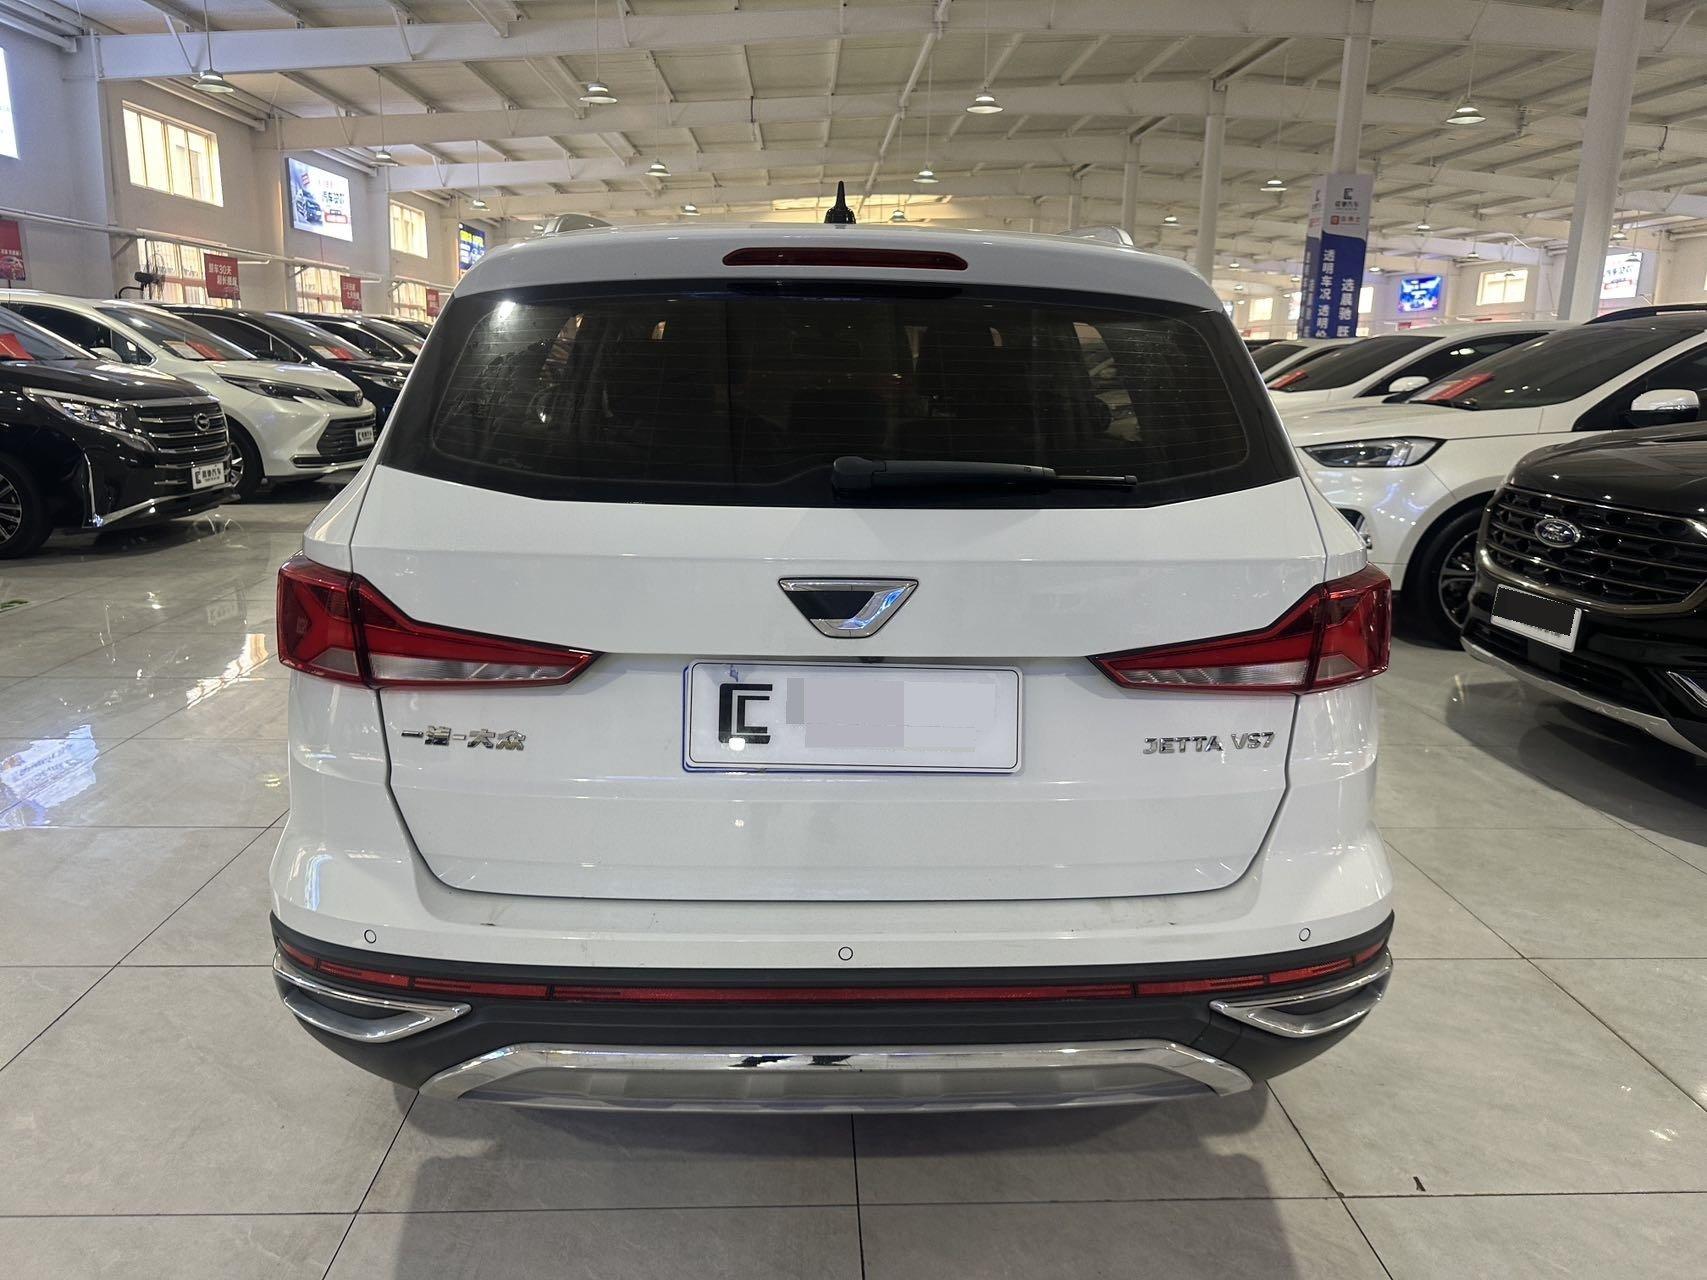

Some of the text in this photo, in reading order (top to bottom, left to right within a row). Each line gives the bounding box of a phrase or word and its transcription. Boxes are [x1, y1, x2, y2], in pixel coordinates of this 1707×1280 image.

[1319, 249, 1336, 300] 透明车况
[1143, 731, 1276, 754] JETTA VS7
